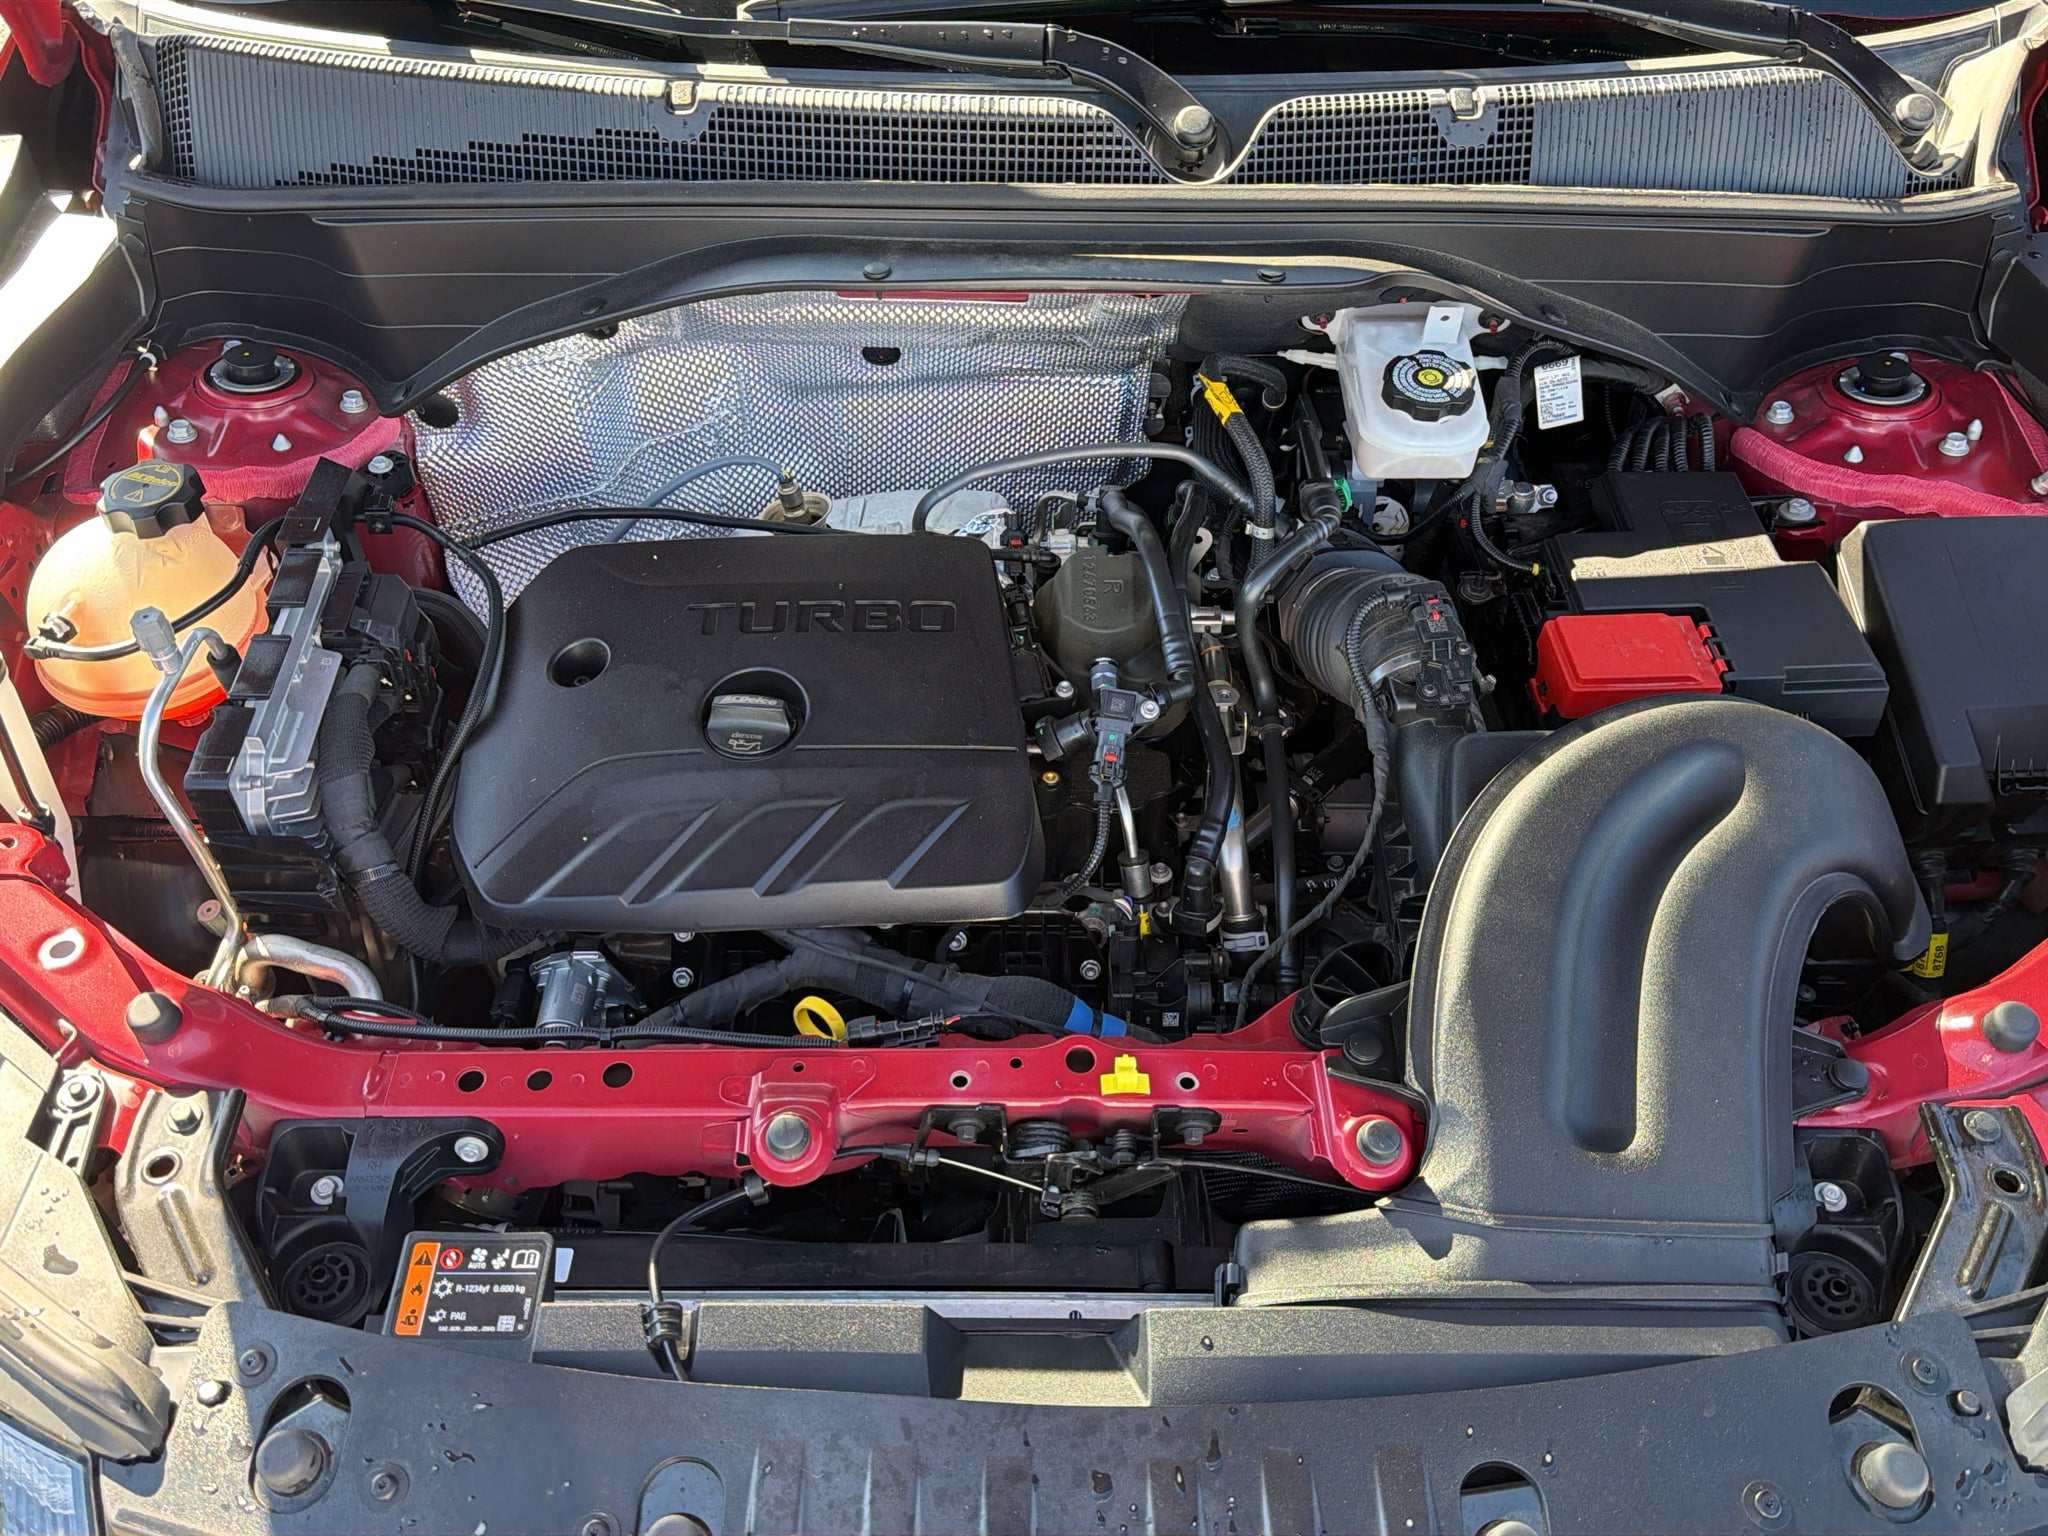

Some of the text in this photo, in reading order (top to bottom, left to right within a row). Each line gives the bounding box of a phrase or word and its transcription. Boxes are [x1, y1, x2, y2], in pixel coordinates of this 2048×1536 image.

[123, 471, 179, 487] ACDelco
[1102, 578, 1124, 596] R
[683, 600, 958, 636] TURBO
[719, 695, 778, 706] ACDelco
[730, 731, 764, 740] dexos
[1931, 944, 1945, 972] 8768
[467, 1262, 487, 1270] AUTO
[455, 1284, 526, 1294] R-1234yf 0.600 kg
[450, 1311, 467, 1321] PAG
